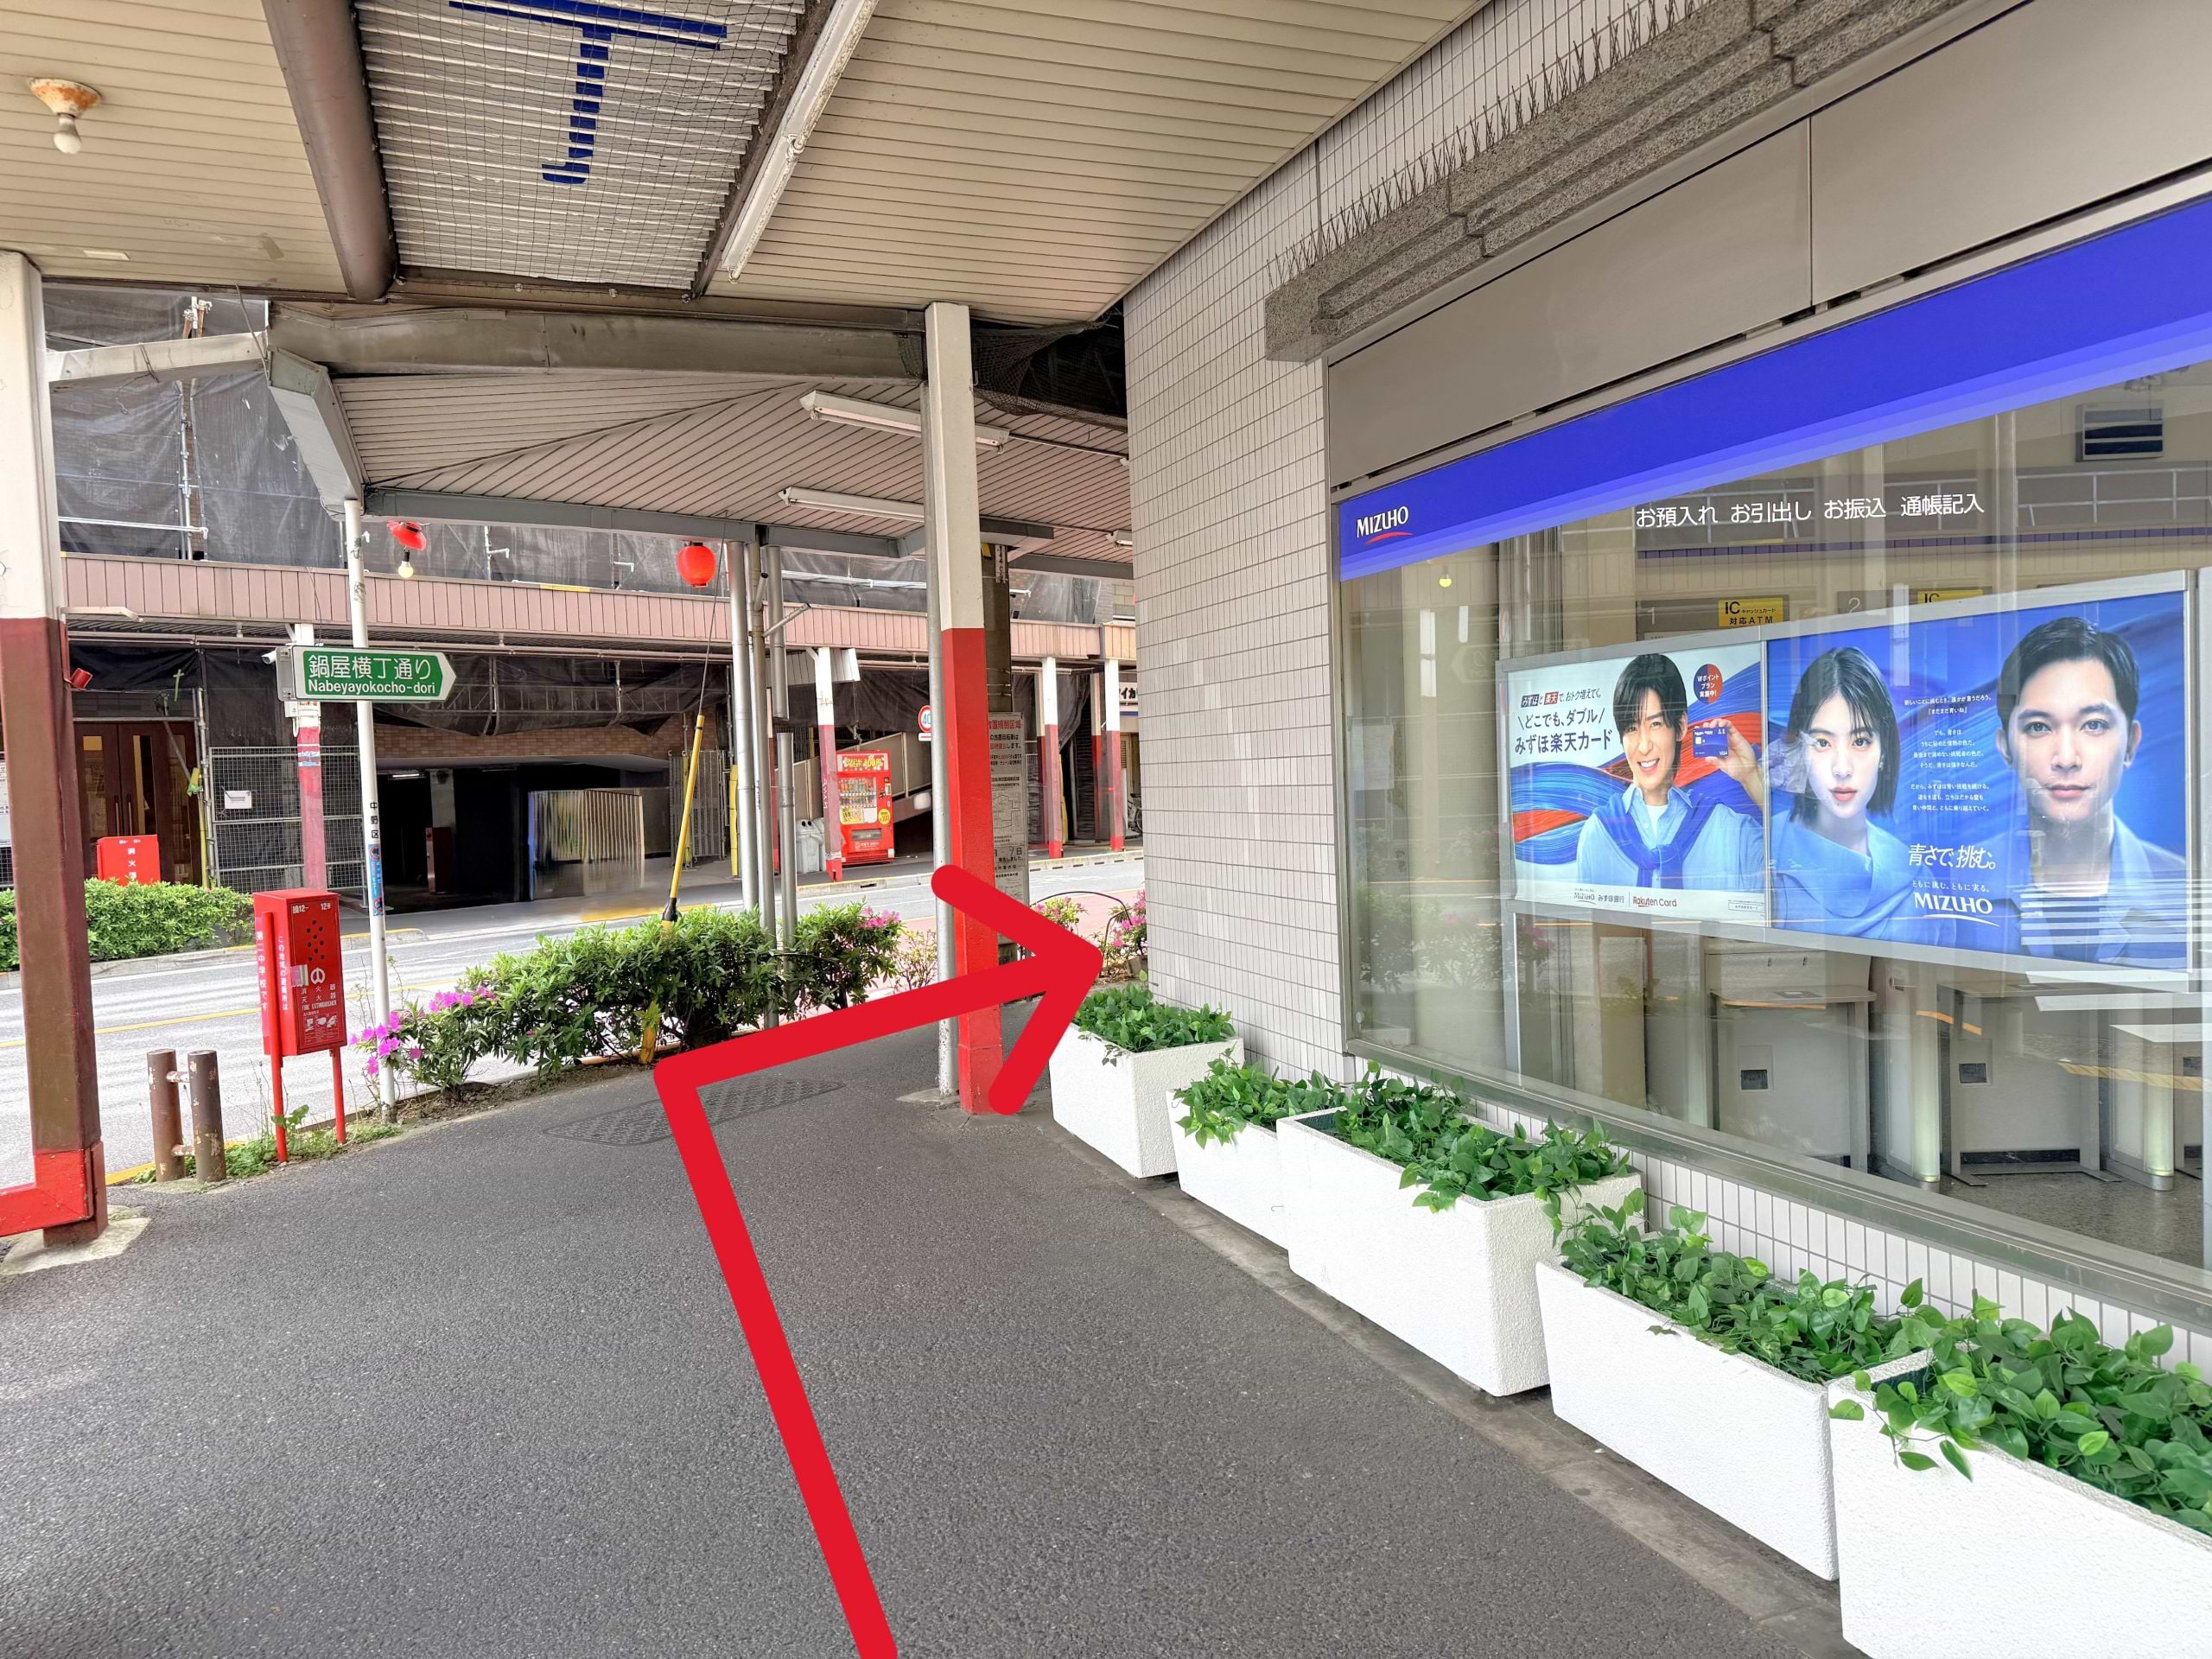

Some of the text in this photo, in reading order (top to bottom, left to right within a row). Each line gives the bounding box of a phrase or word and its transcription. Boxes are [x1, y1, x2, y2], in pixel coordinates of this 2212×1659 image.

[1636, 493, 1985, 528] お預入れ お引出し お振込 通帳記入
[1357, 506, 1409, 538] MIZUHO
[1647, 607, 1656, 625] 1
[1725, 601, 1740, 614] IC
[1730, 616, 1773, 626] 対応ATM
[308, 654, 432, 680] 鍋屋横丁通り
[308, 679, 435, 695] Nabeyayokocho-dori
[1515, 729, 1613, 755] みずほ楽天カード
[370, 802, 379, 838] 中野区
[1908, 843, 1996, 870] 青さで、挑む。
[1912, 880, 1990, 893] ともに挑む。ともに実る。
[1633, 896, 1677, 907] Rakuten Card
[1913, 892, 1993, 914] MIZUHO
